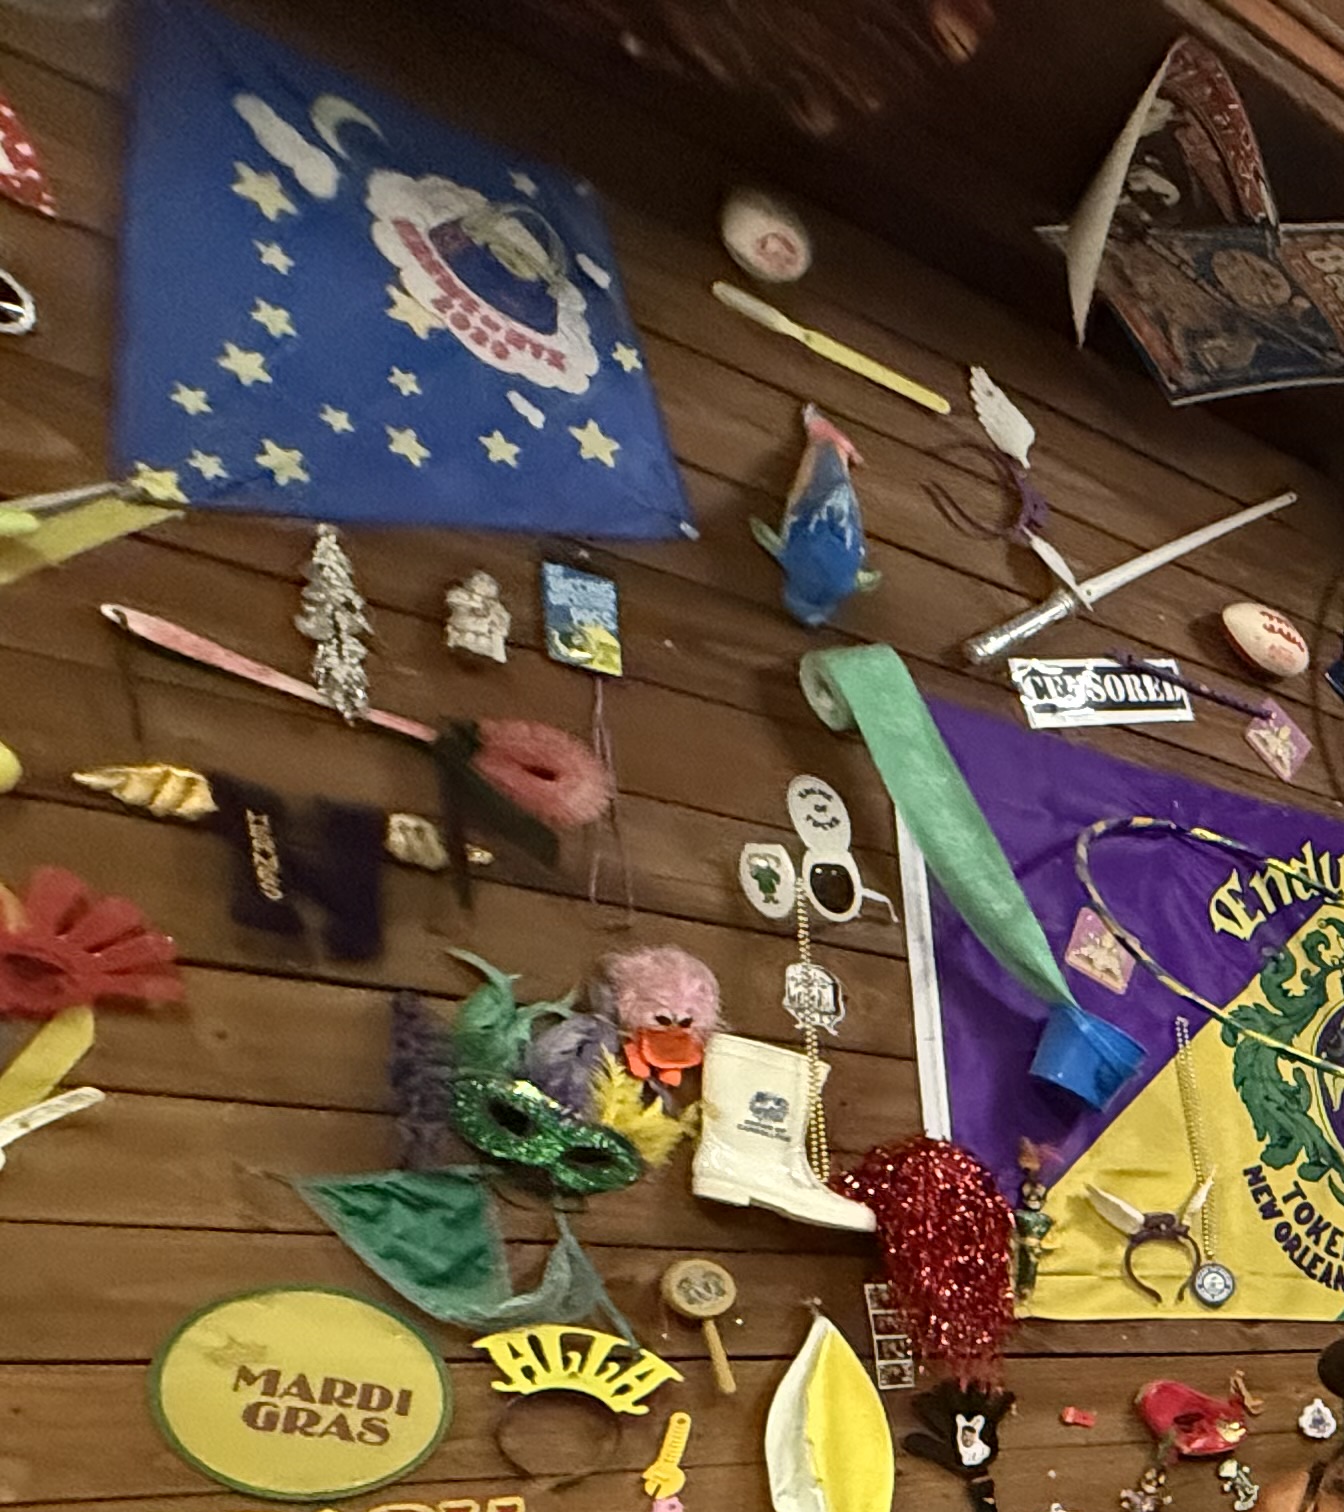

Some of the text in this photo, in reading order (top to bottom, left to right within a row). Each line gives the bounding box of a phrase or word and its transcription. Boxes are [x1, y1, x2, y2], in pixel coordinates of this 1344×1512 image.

[1242, 1164, 1285, 1222] NEW
[231, 1364, 413, 1417] MARDI
[240, 1401, 391, 1447] GRAS
